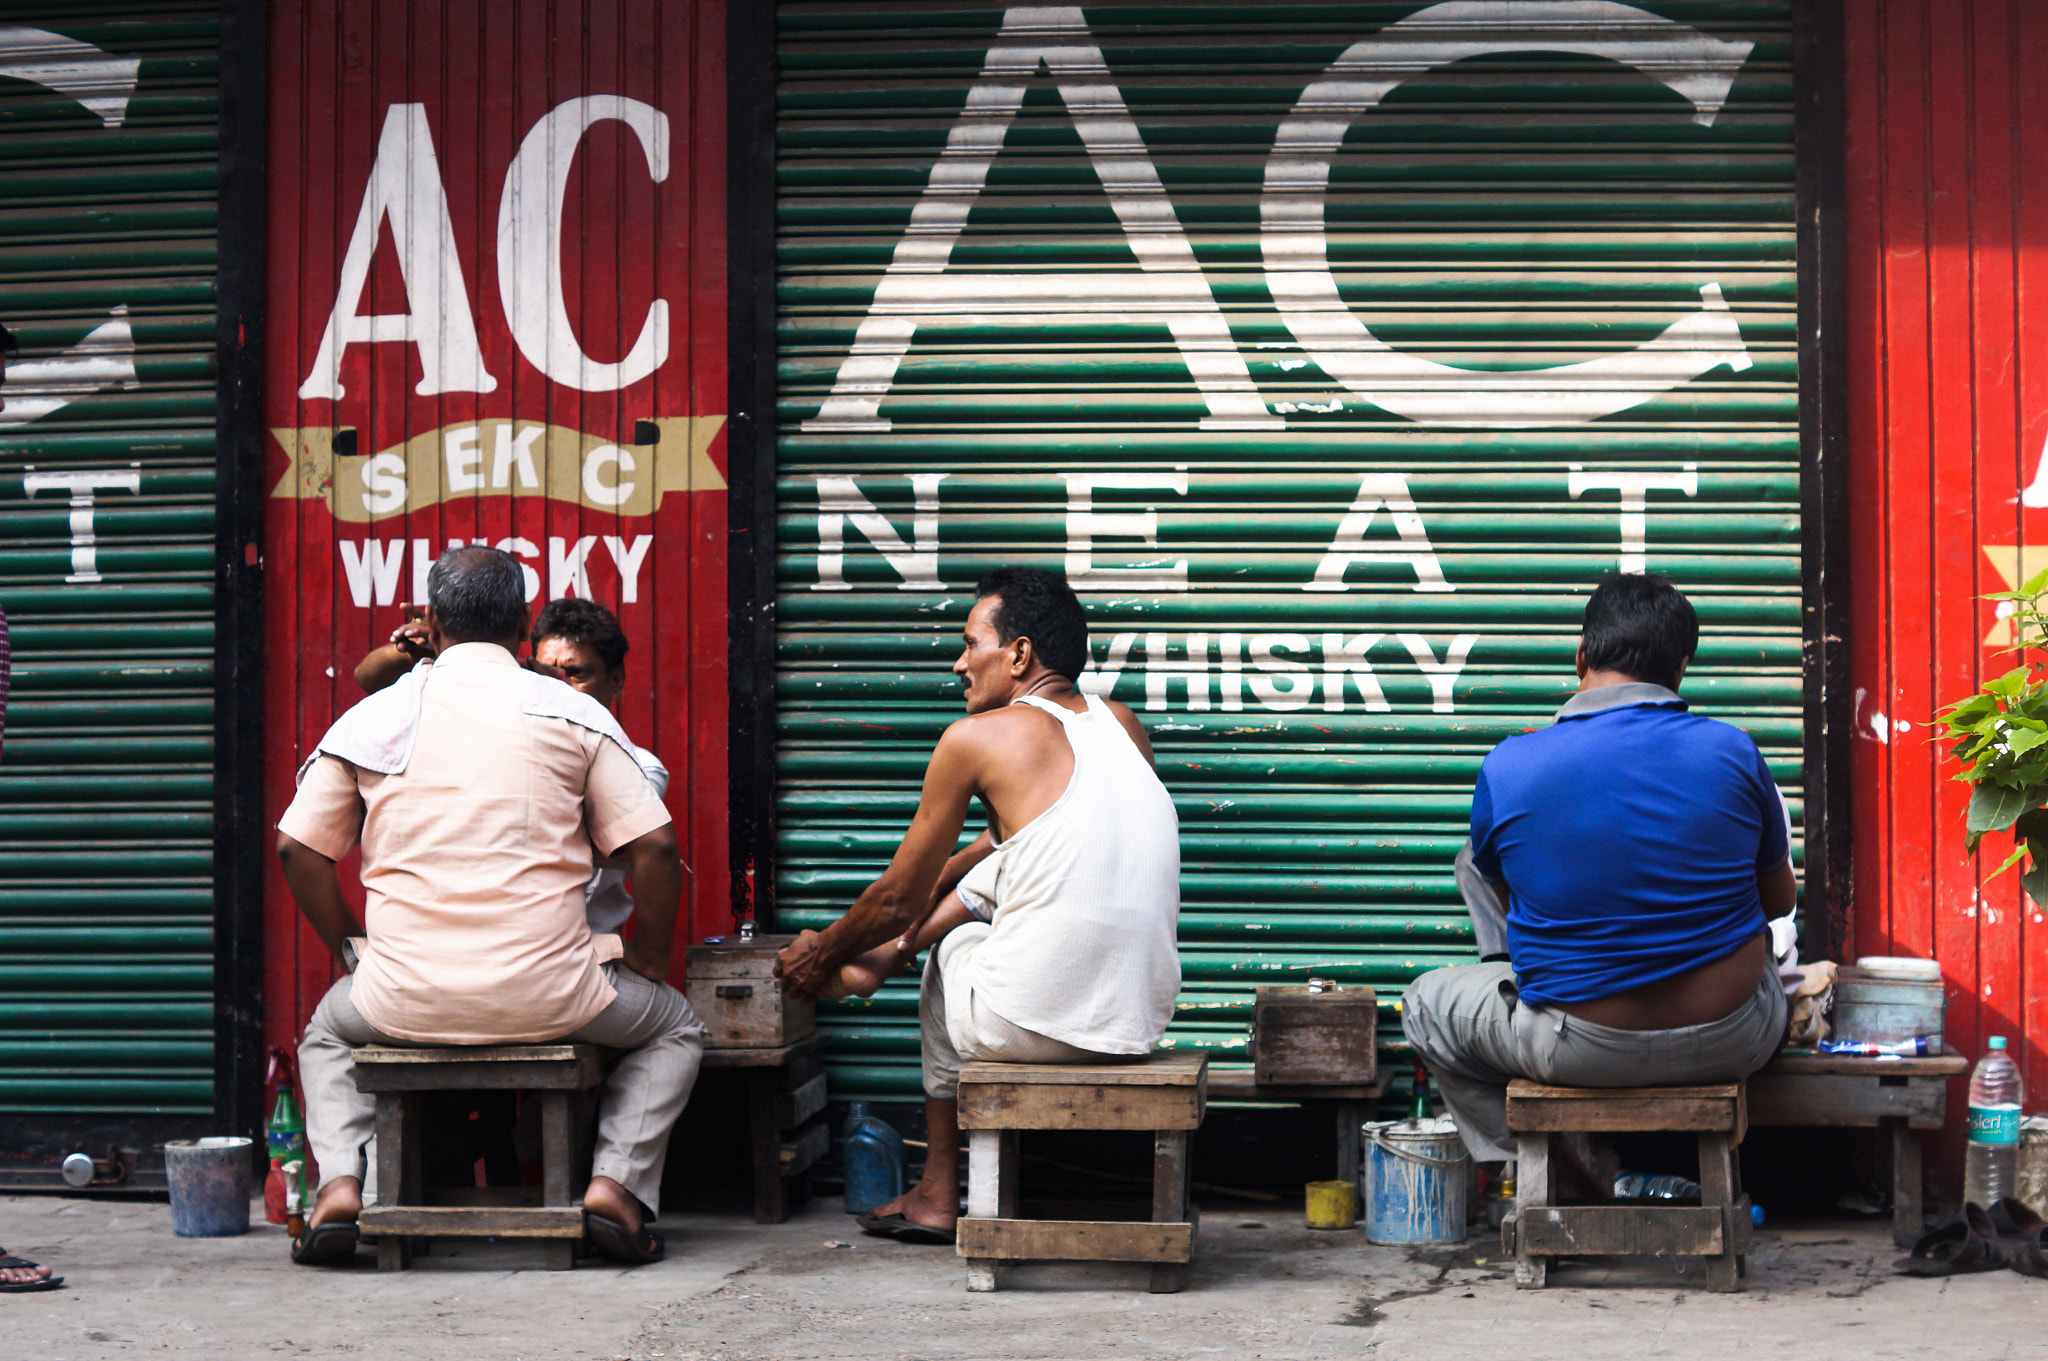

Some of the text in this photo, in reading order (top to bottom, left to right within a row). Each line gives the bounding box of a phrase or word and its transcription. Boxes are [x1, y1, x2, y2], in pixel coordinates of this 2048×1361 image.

[298, 94, 670, 400] AC
[801, 1, 1755, 431] AC
[339, 534, 654, 609] WHSKY
[810, 464, 1698, 591] NEAT
